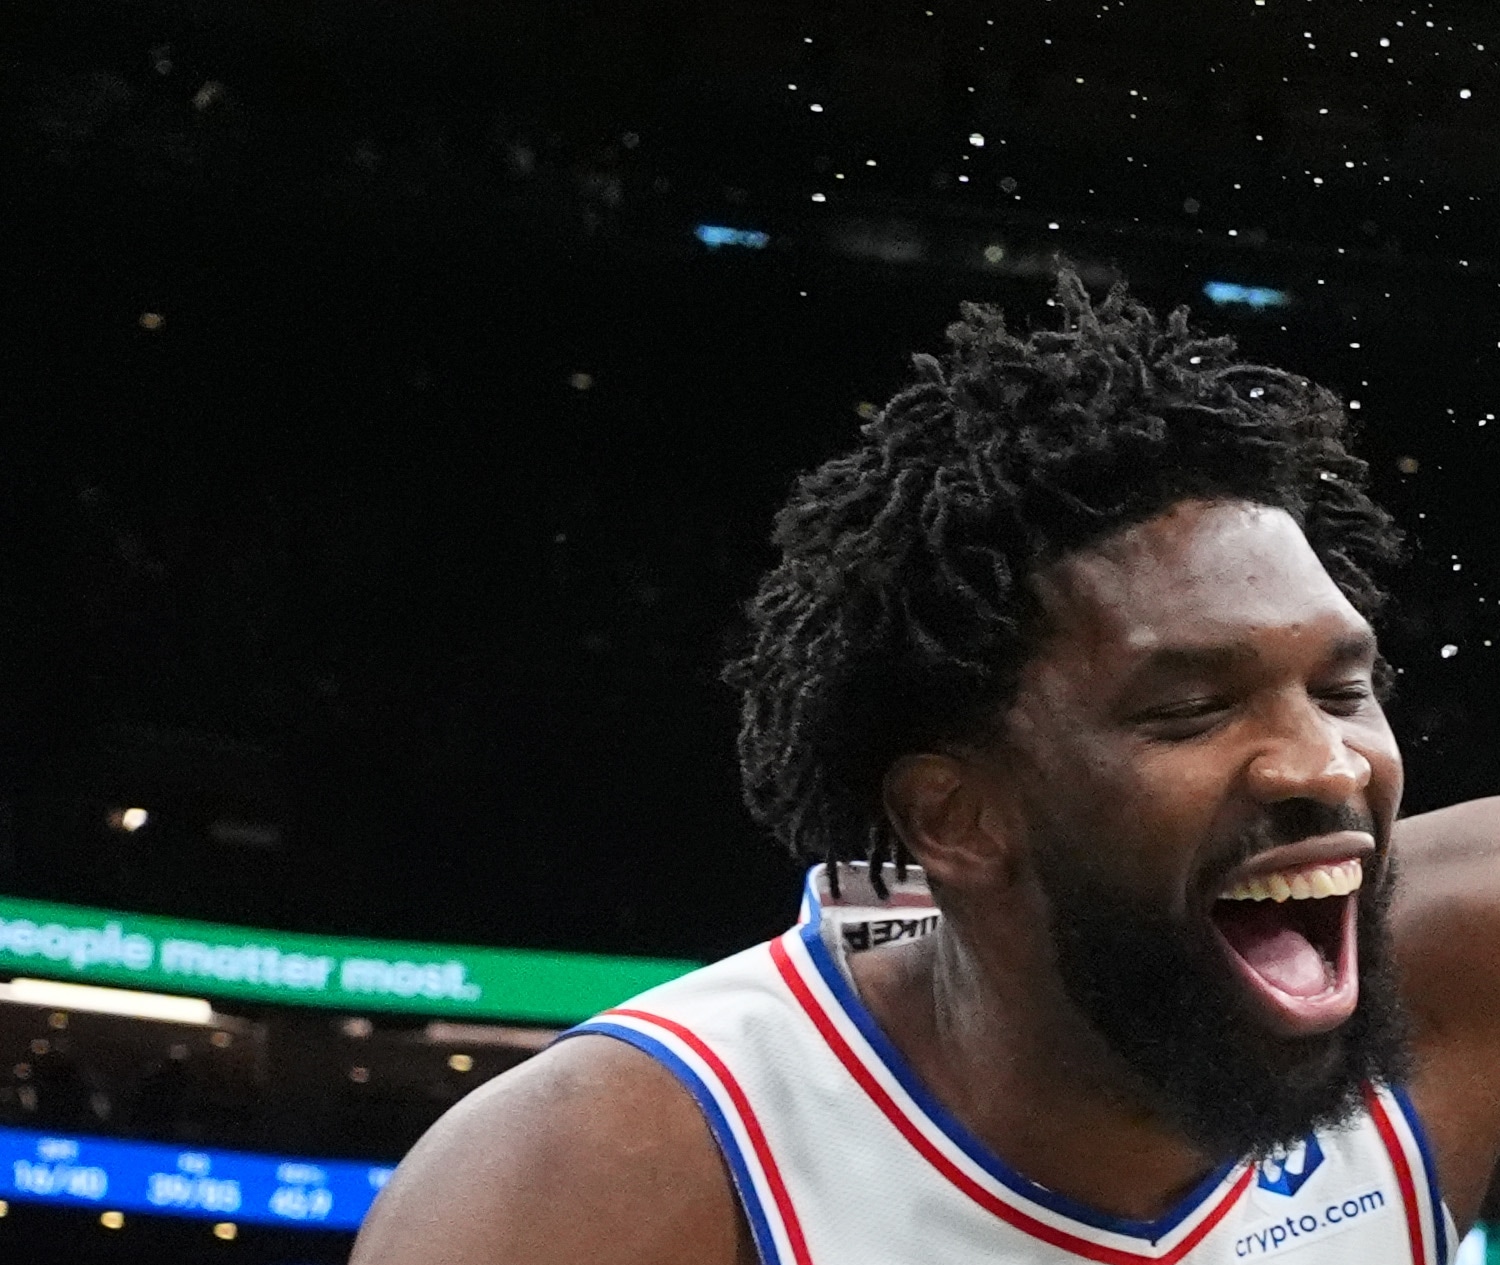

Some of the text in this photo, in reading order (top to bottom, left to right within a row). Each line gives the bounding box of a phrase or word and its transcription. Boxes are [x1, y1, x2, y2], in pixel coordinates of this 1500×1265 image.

[0, 917, 481, 1002] eople matter most.
[1235, 1190, 1385, 1258] crypto.com
